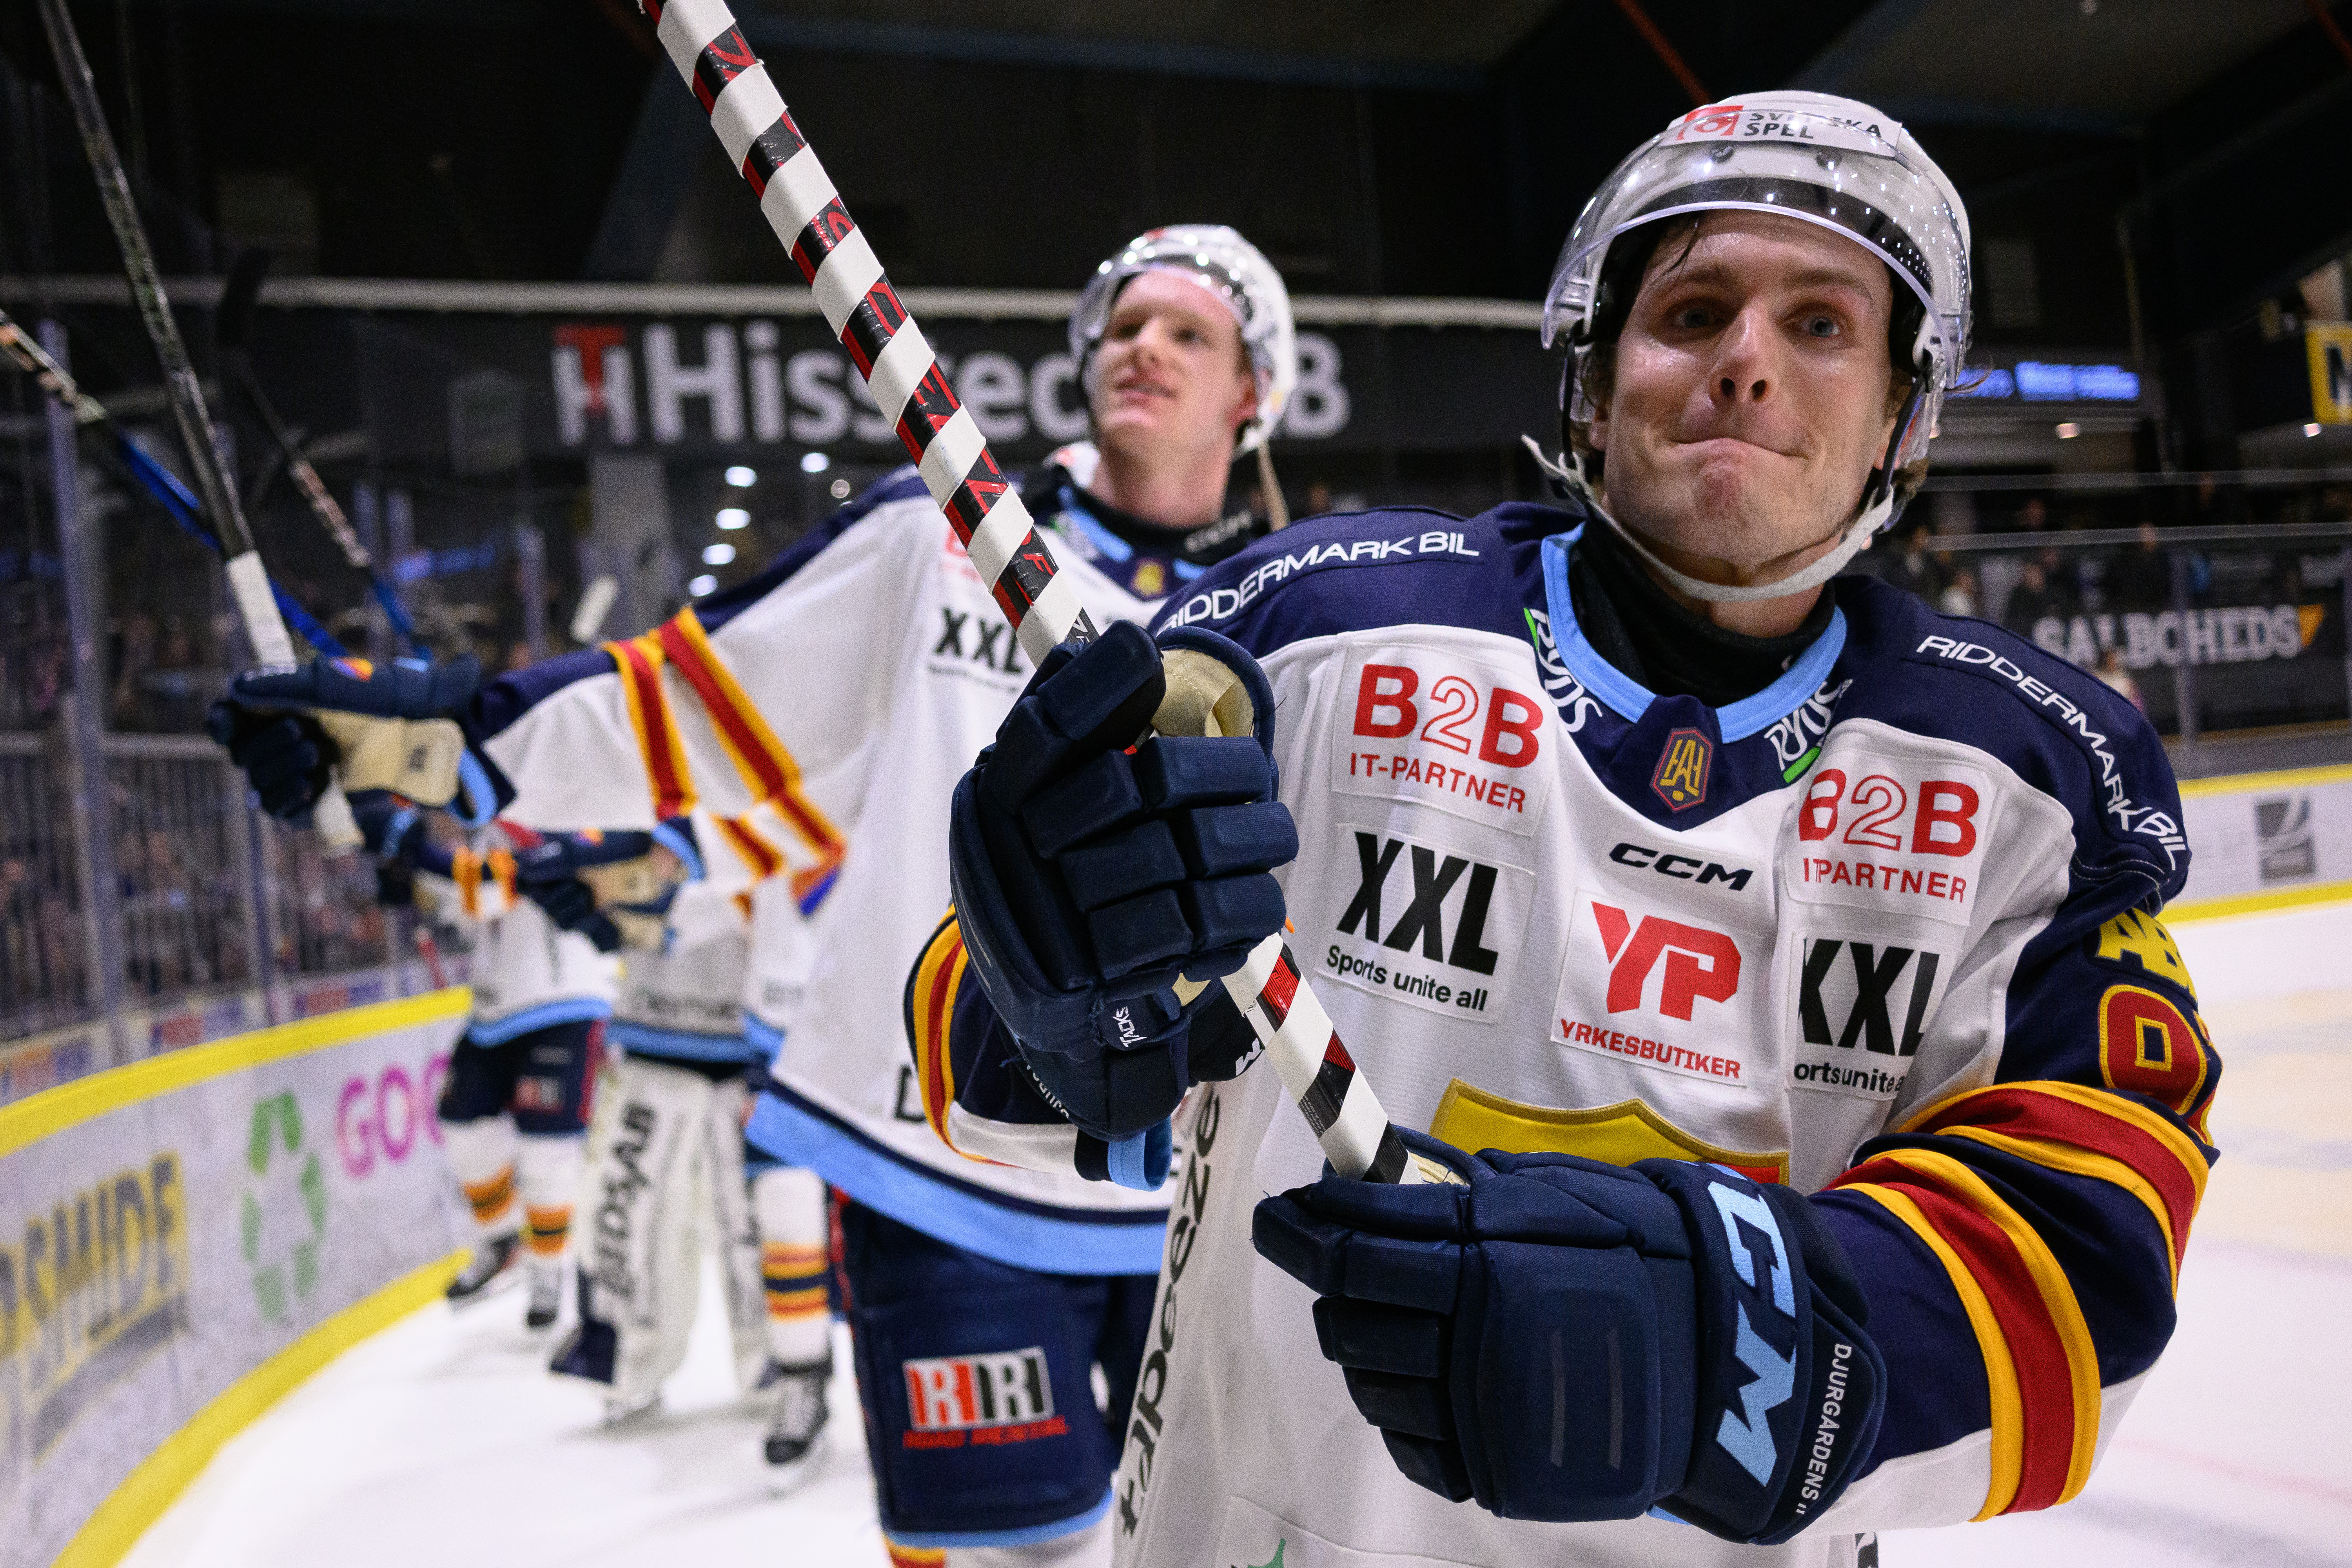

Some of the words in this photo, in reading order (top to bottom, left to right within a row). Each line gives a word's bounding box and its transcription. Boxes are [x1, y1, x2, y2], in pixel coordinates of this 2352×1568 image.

[1744, 123, 1814, 139] SPEL
[1419, 531, 1479, 557] BIL
[935, 606, 1022, 674] XXL
[1353, 664, 1544, 768] B2B
[1351, 752, 1526, 813] IT-PARTNER
[1916, 634, 2152, 831] RIDDERMARK
[2134, 811, 2188, 871] BIL
[1798, 768, 1980, 857] B2B
[1609, 842, 1753, 891] CCM
[1337, 831, 1499, 976] XXL
[1327, 944, 1388, 984] Sports
[1393, 971, 1451, 1003] unite
[1456, 988, 1488, 1011] all
[1591, 901, 1741, 1021] YP
[1112, 1006, 1147, 1047] TACKS
[1798, 937, 1940, 1056] XXL
[1560, 1019, 1740, 1079] YRKESBUTIKER
[1841, 1067, 1895, 1093] unite
